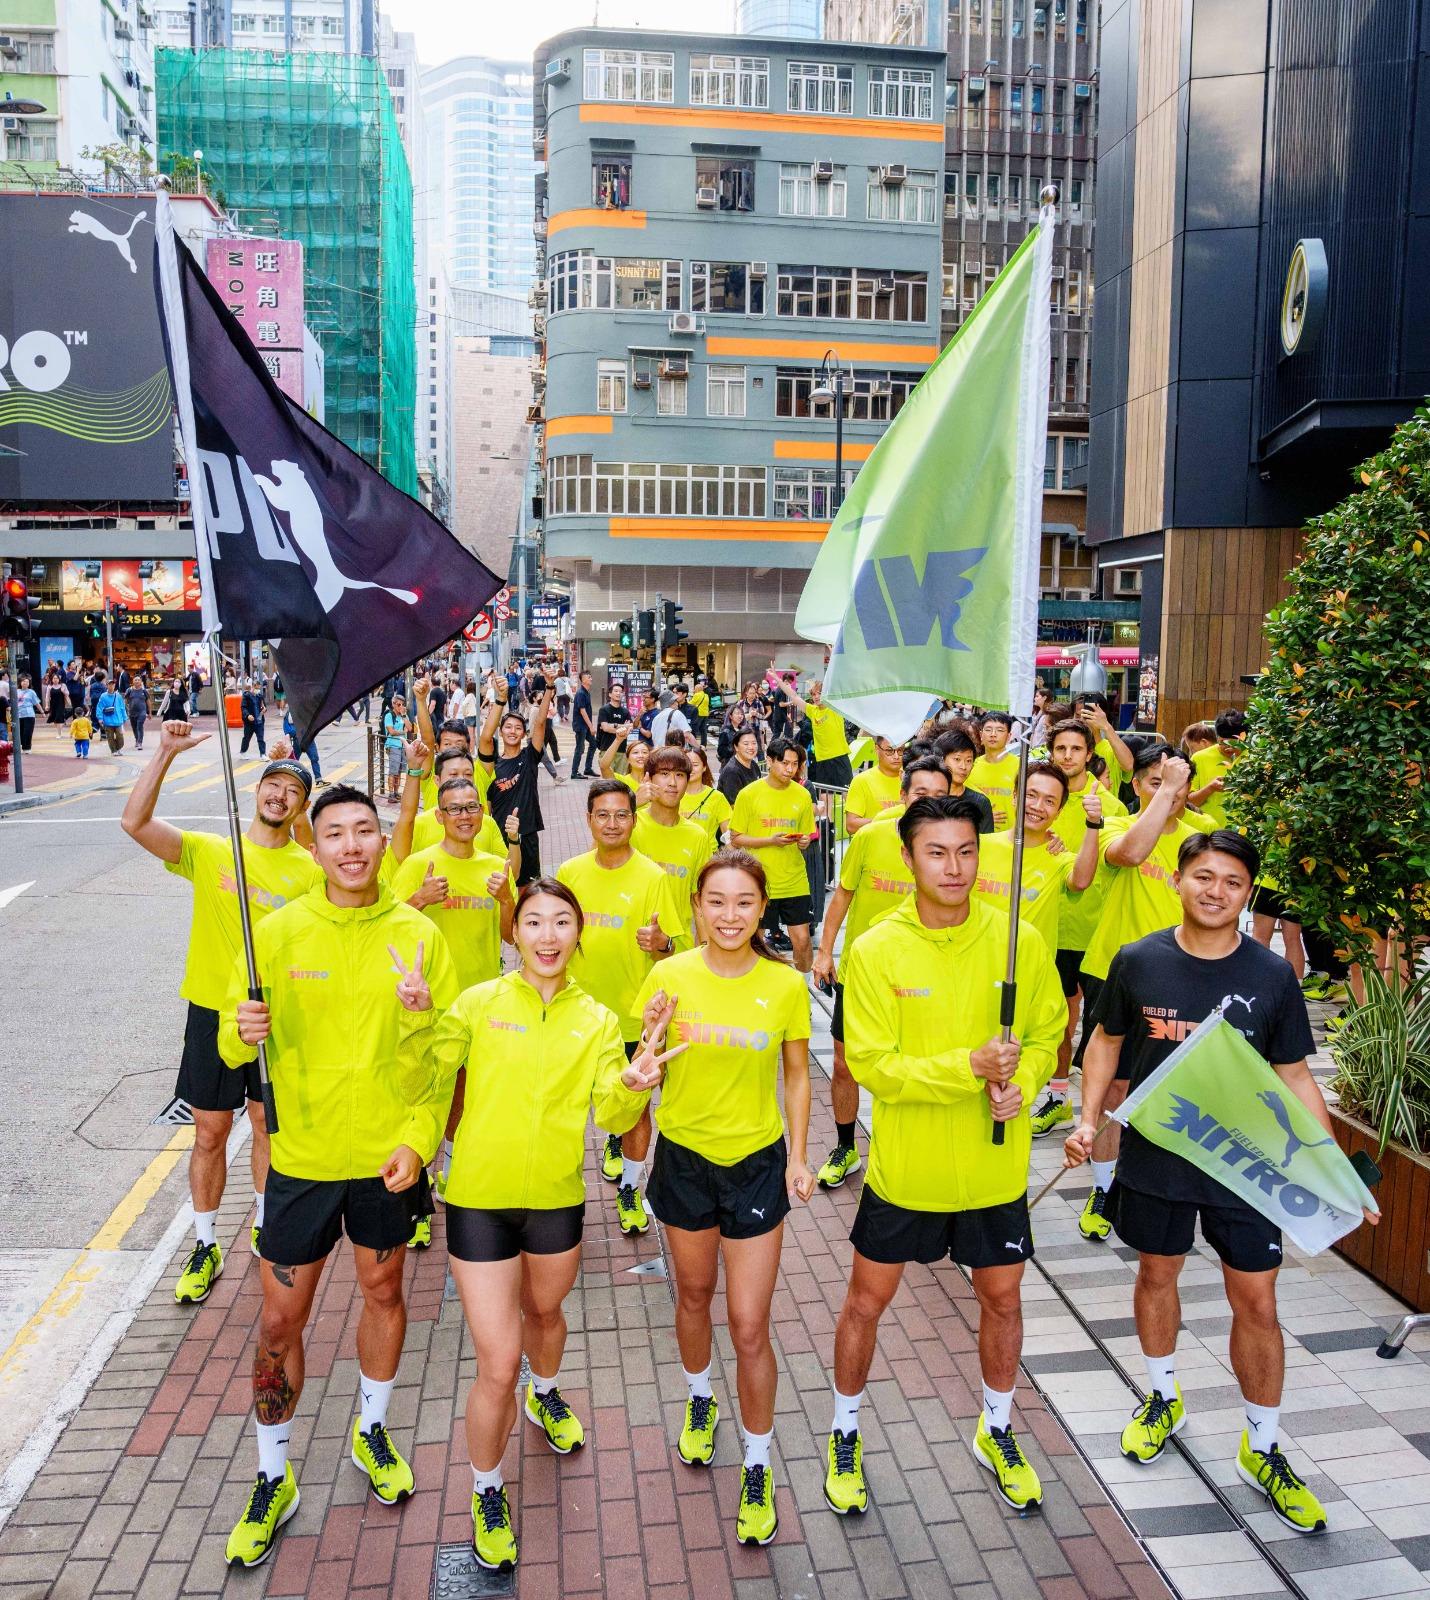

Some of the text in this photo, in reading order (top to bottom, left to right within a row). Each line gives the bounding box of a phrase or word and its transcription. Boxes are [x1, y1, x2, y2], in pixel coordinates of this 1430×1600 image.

[616, 266, 661, 278] SUNNY FIT
[591, 621, 618, 631] new
[975, 875, 1040, 903] NITO
[287, 969, 329, 980] NITRO
[890, 984, 929, 998] NITRO
[1142, 1006, 1178, 1018] FUELED BY
[487, 1018, 527, 1033] NITRO
[671, 1021, 770, 1052] NITRO
[1229, 1127, 1265, 1157] FUELED
[1154, 1091, 1340, 1222] NITRO TM
